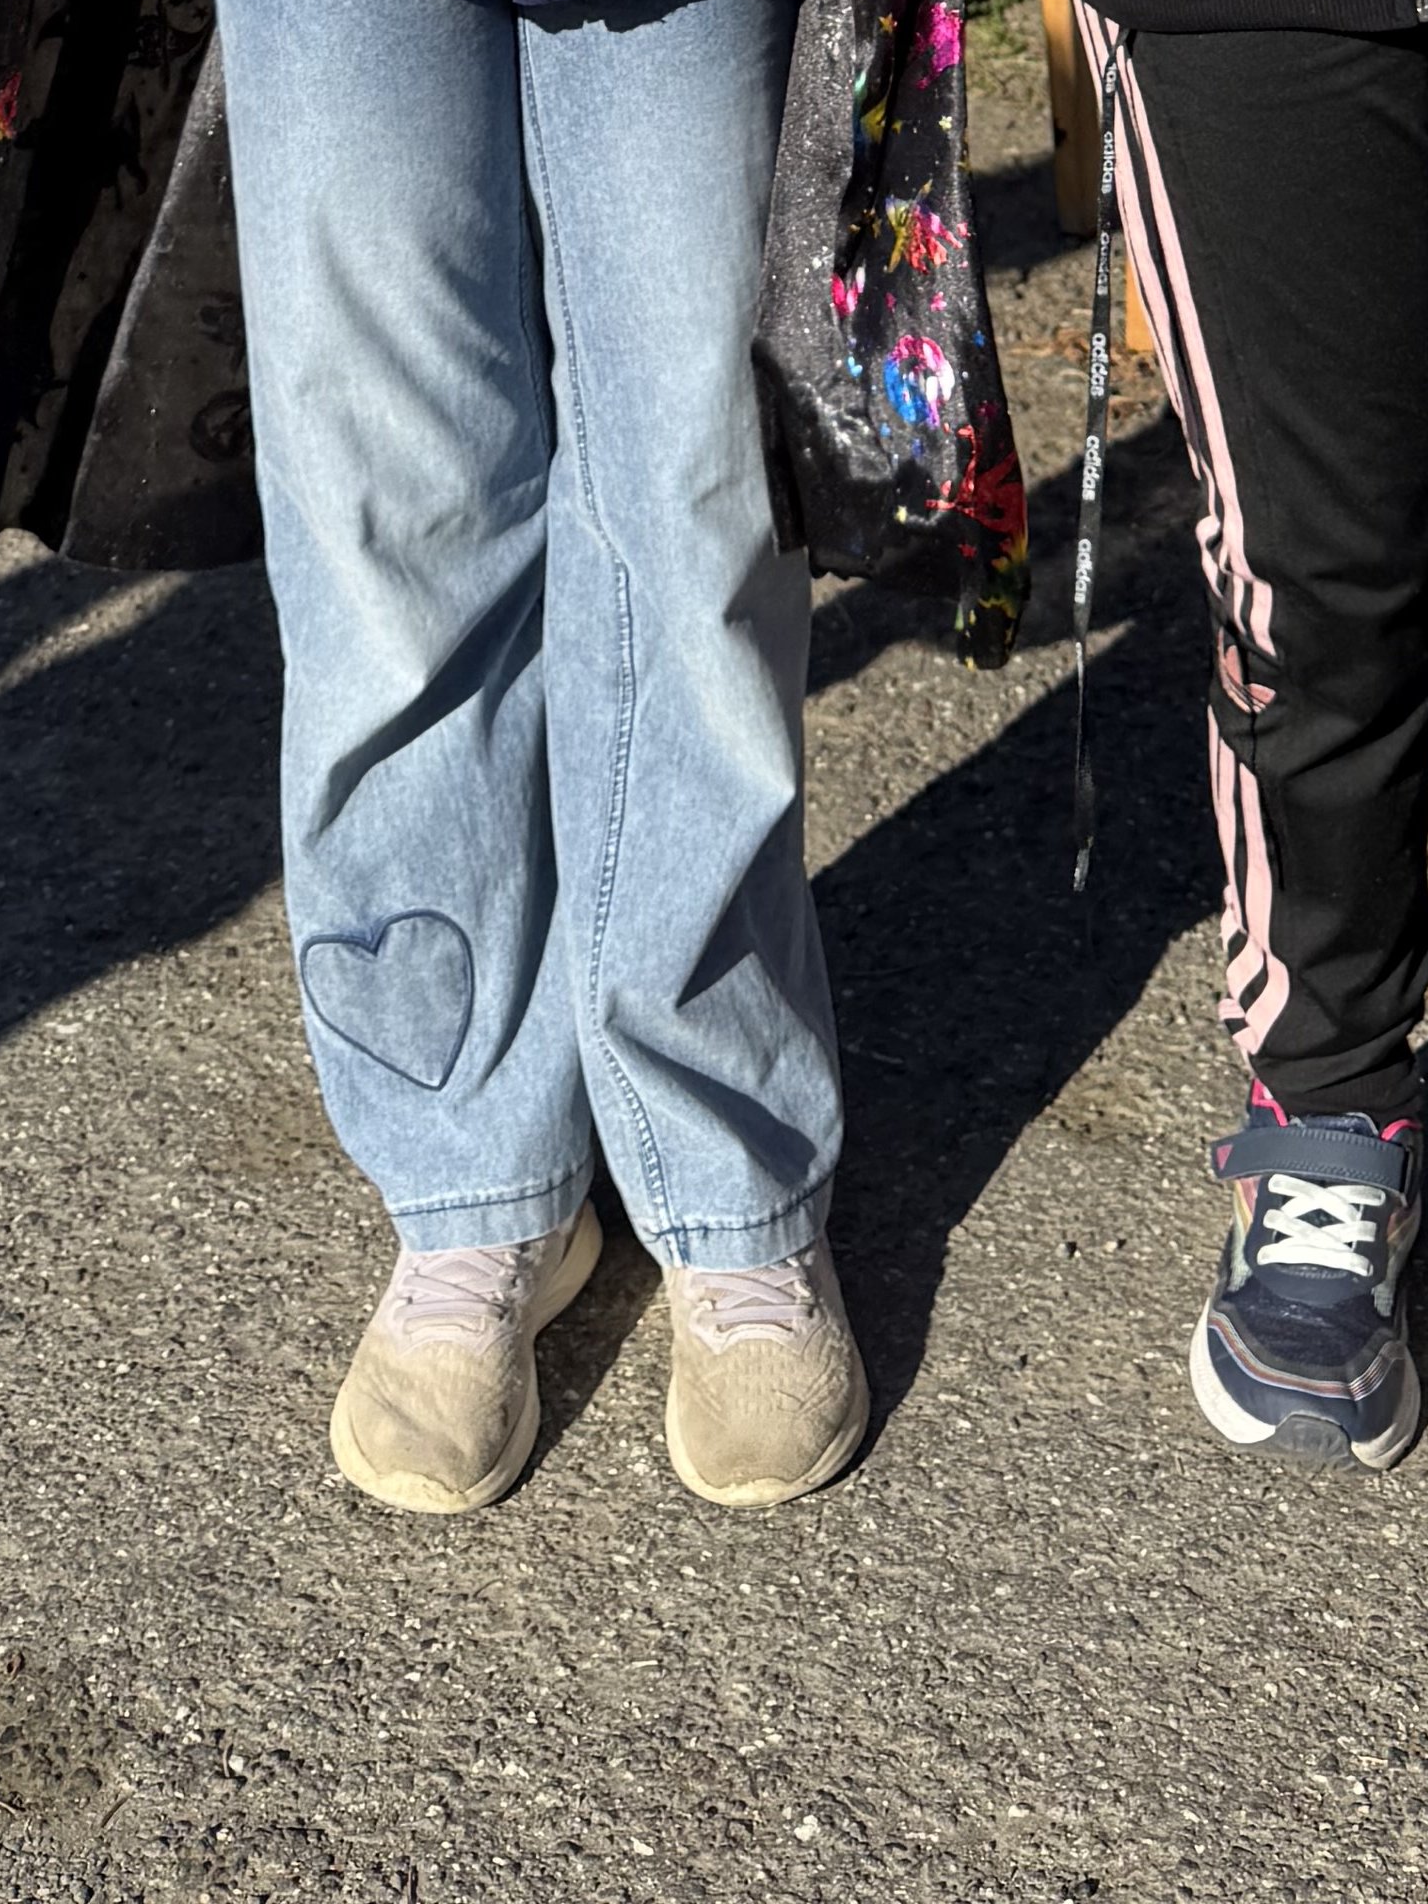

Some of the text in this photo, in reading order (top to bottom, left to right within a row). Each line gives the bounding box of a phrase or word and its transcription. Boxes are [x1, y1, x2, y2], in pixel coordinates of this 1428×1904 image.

[1101, 131, 1116, 194] adidas
[1090, 332, 1109, 398] adidas
[1082, 434, 1102, 501] adidas
[1074, 538, 1093, 605] adidas
